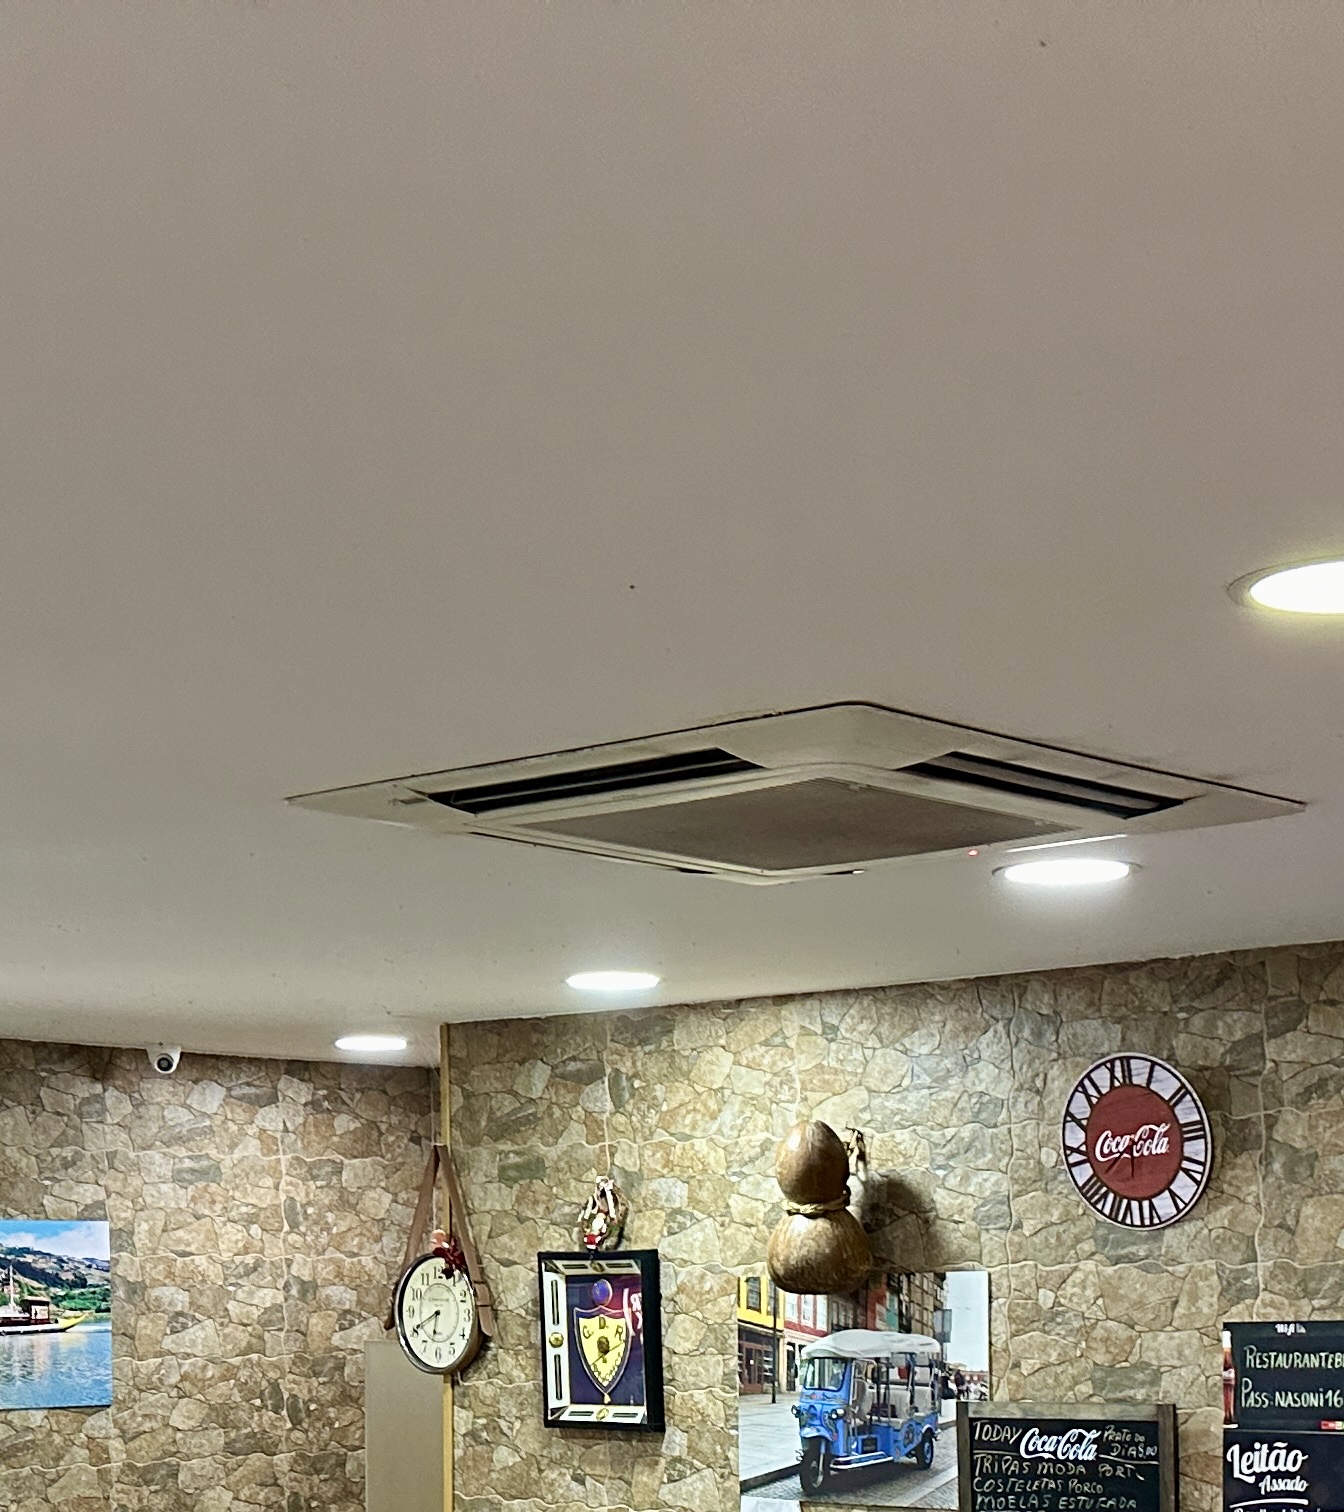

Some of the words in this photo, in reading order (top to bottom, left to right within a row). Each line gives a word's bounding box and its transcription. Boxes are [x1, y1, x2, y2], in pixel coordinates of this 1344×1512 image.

[421, 1273, 430, 1286] 11
[411, 1288, 423, 1301] 10
[459, 1290, 467, 1303] 2
[407, 1305, 415, 1318] 9
[463, 1308, 471, 1322] 3
[421, 1340, 429, 1355] 7
[435, 1346, 442, 1361] 6
[448, 1342, 456, 1358] 5
[973, 1420, 1022, 1444] TODAY
[1019, 1427, 1102, 1461] Coca-Cola
[973, 1453, 1031, 1477] TRIPAS
[1037, 1461, 1087, 1479] MODA
[1226, 1442, 1309, 1484] Leitão
[973, 1477, 1064, 1493] COSTELETAS
[1069, 1479, 1104, 1494] PORCO
[1258, 1474, 1310, 1496] Assado
[975, 1494, 1053, 1510] MOELAS
